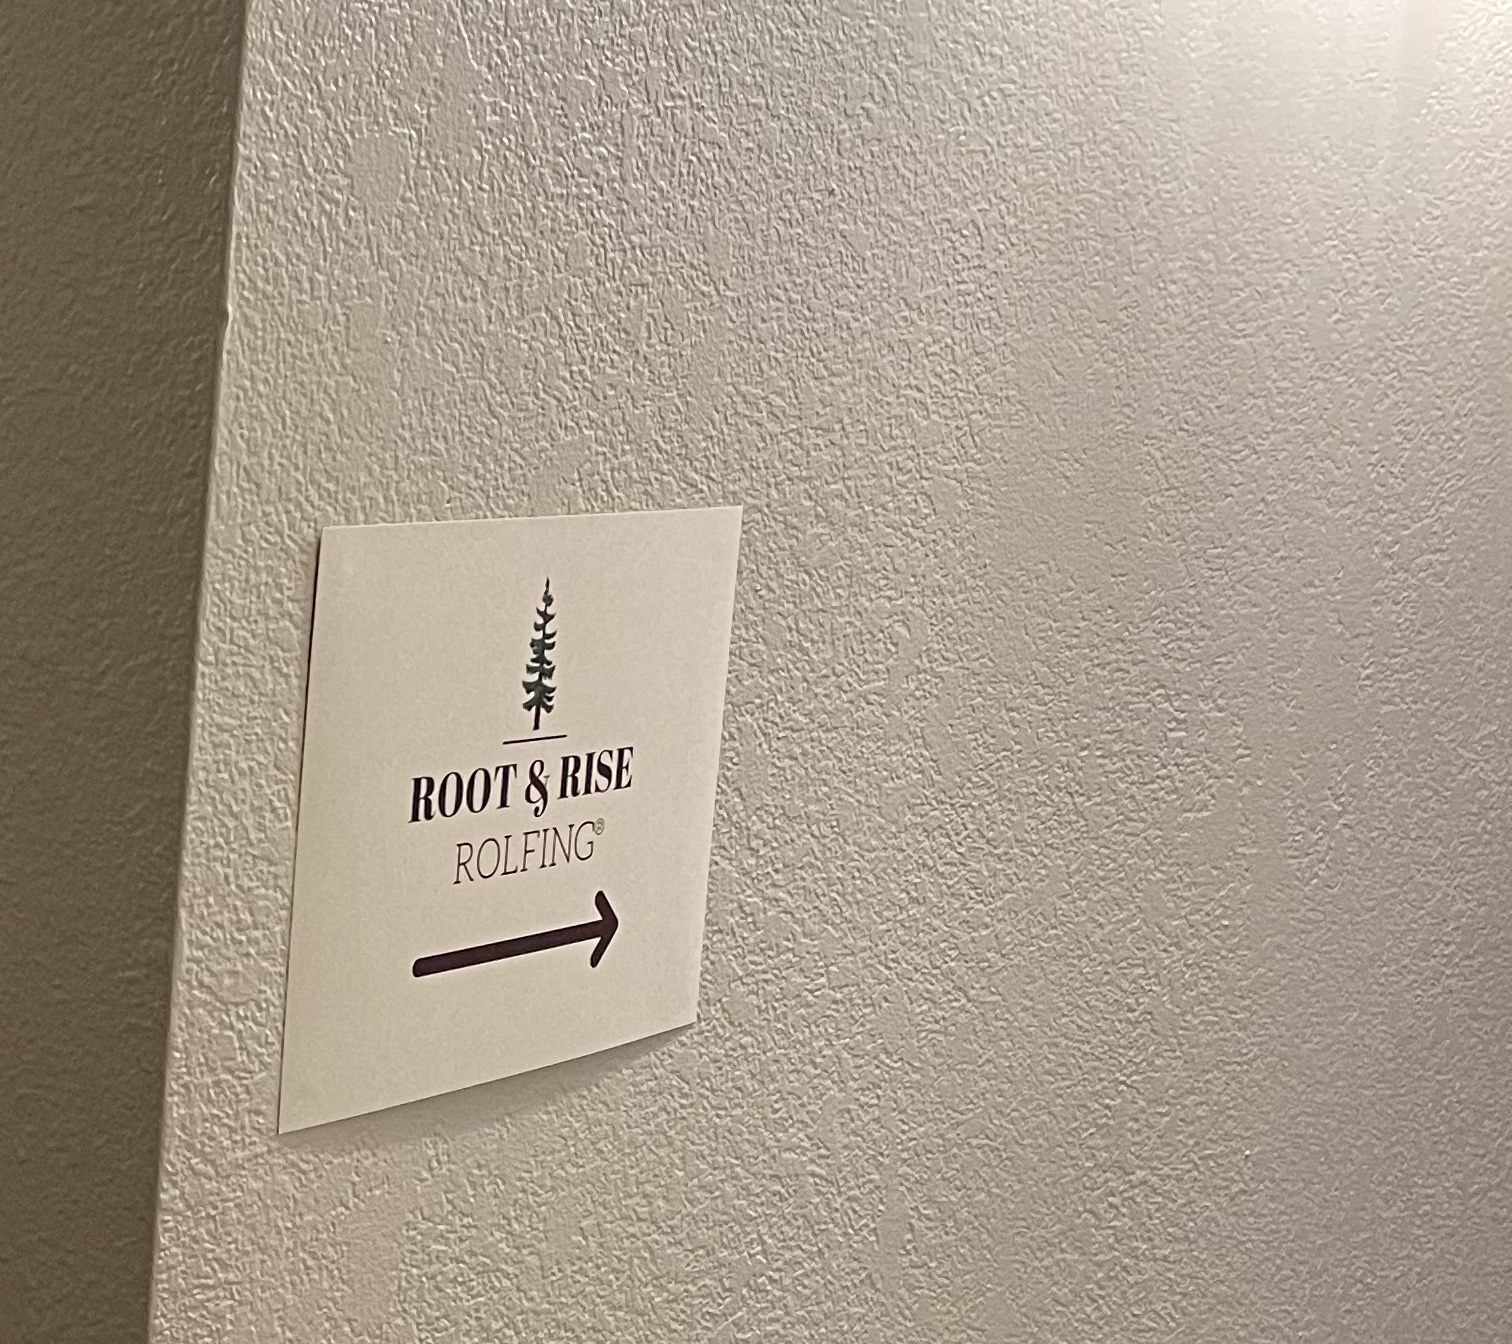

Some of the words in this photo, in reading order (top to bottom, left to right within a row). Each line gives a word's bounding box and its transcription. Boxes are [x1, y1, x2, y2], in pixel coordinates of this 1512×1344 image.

[407, 762, 518, 824] ROOT
[524, 758, 551, 818] &
[556, 745, 635, 801] RISE
